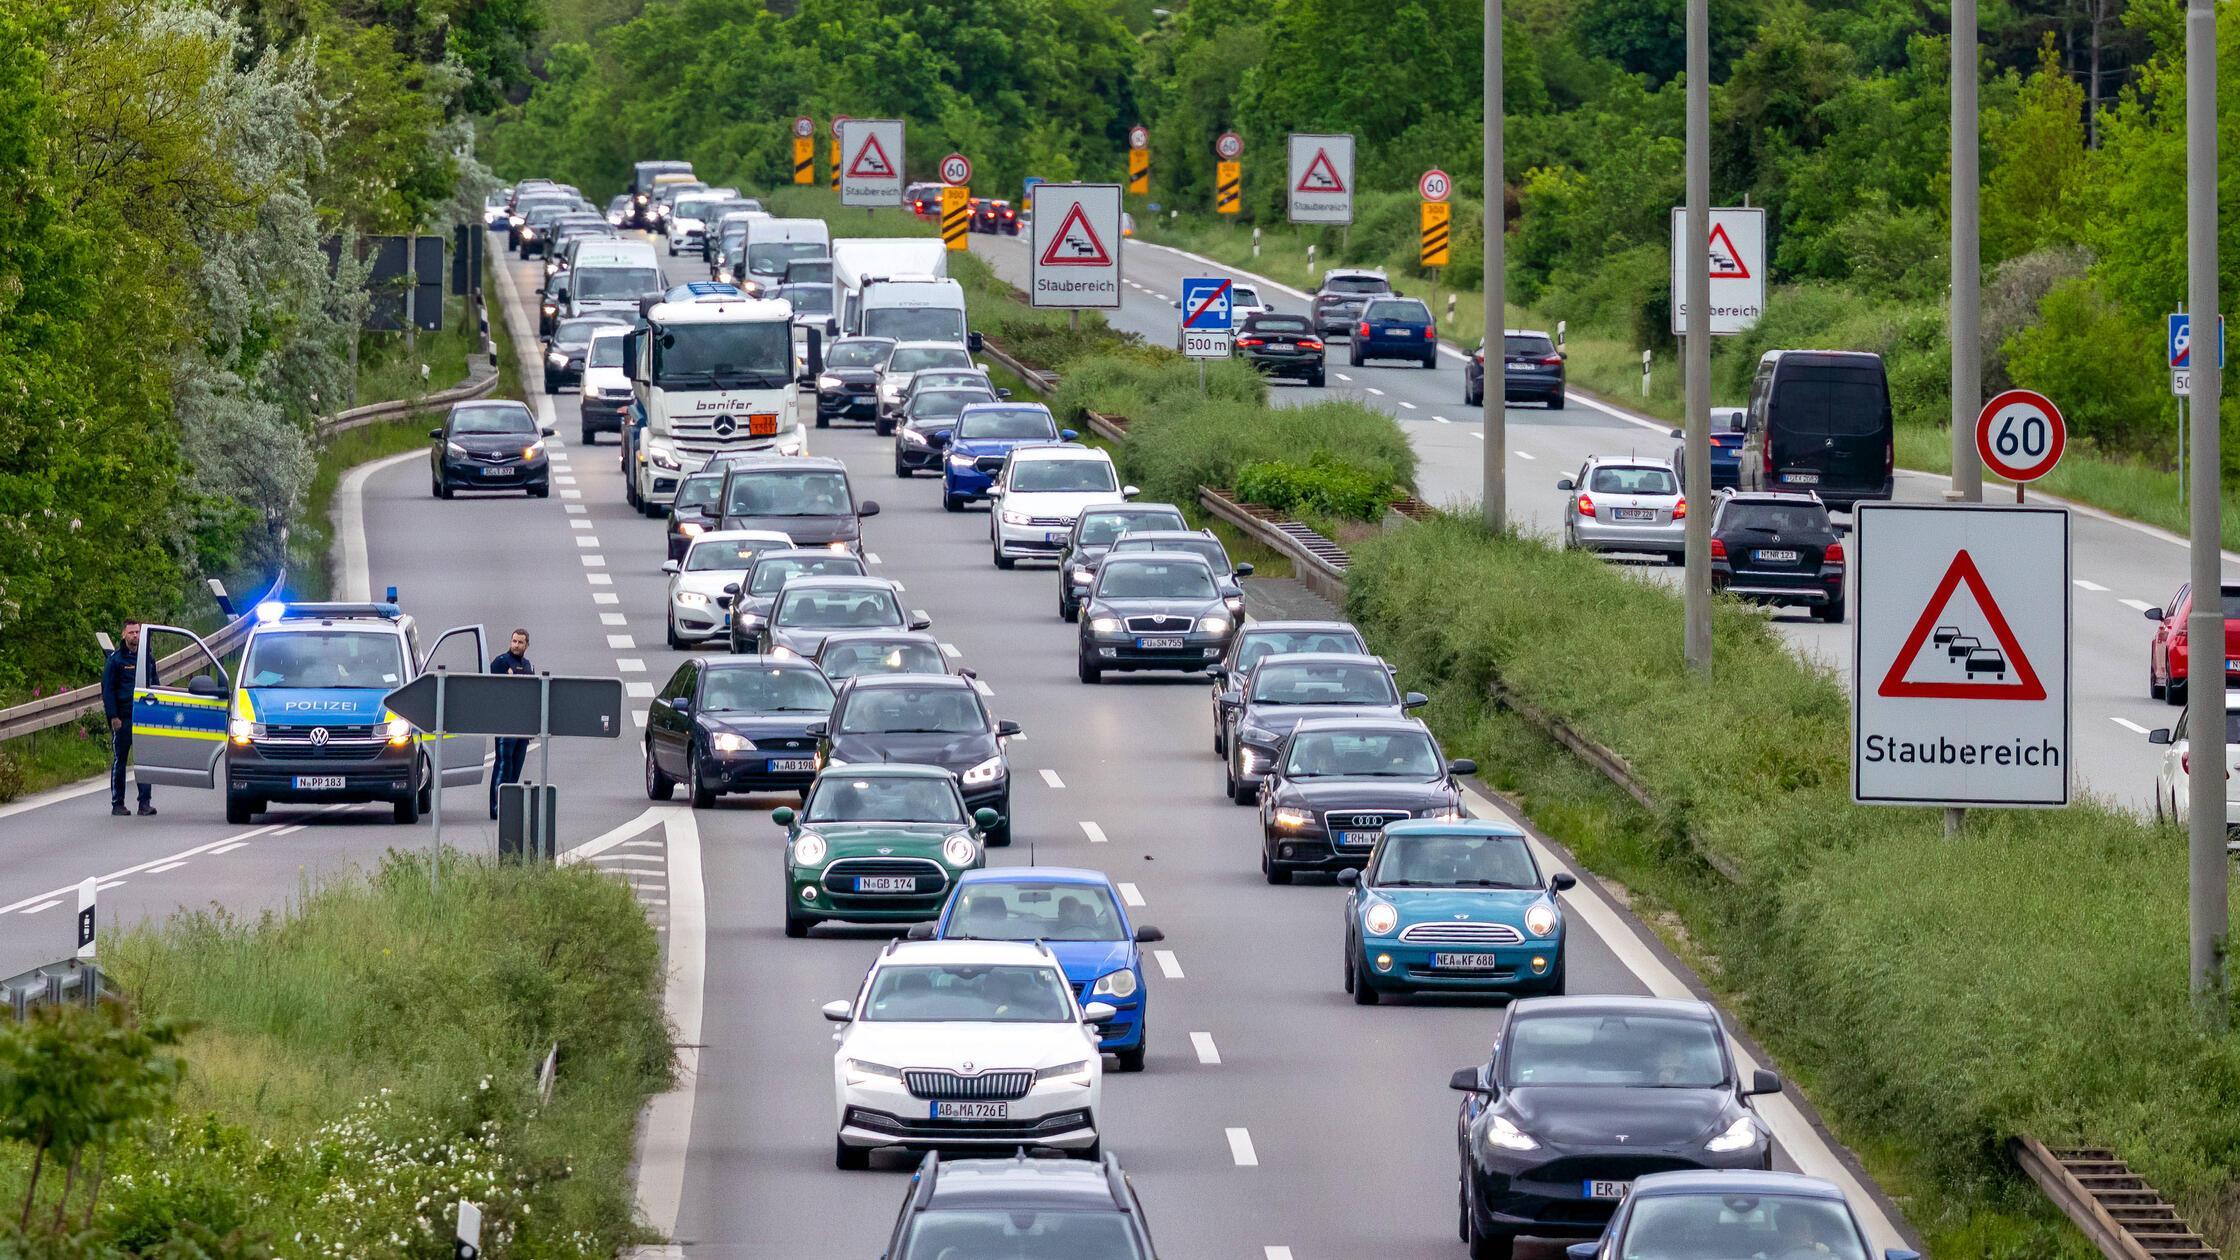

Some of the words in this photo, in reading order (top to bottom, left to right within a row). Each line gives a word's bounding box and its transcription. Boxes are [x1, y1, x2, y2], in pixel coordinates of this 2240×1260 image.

[946, 163, 965, 178] 60
[1427, 179, 1444, 193] 60
[1038, 279, 1115, 292] Staubereich
[1680, 303, 1758, 316] Sbereich
[1187, 338, 1210, 350] 500
[1215, 341, 1227, 350] m
[1996, 416, 2045, 457] 60
[286, 701, 357, 712] POLIZEI
[1865, 734, 2059, 767] Staubereich
[773, 761, 780, 770] N
[784, 761, 796, 770] AB
[300, 778, 306, 787] N
[312, 778, 323, 787] PP
[324, 778, 342, 787] 183
[1345, 833, 1364, 844] ERH
[863, 878, 871, 889] N
[876, 878, 890, 889] GB
[894, 878, 912, 889] 174
[1437, 954, 1455, 966] NEA
[1462, 955, 1474, 966] KF
[1476, 955, 1494, 966] 688
[939, 1103, 953, 1116] AB
[960, 1104, 974, 1117] MA
[1596, 1182, 1614, 1196] ER
